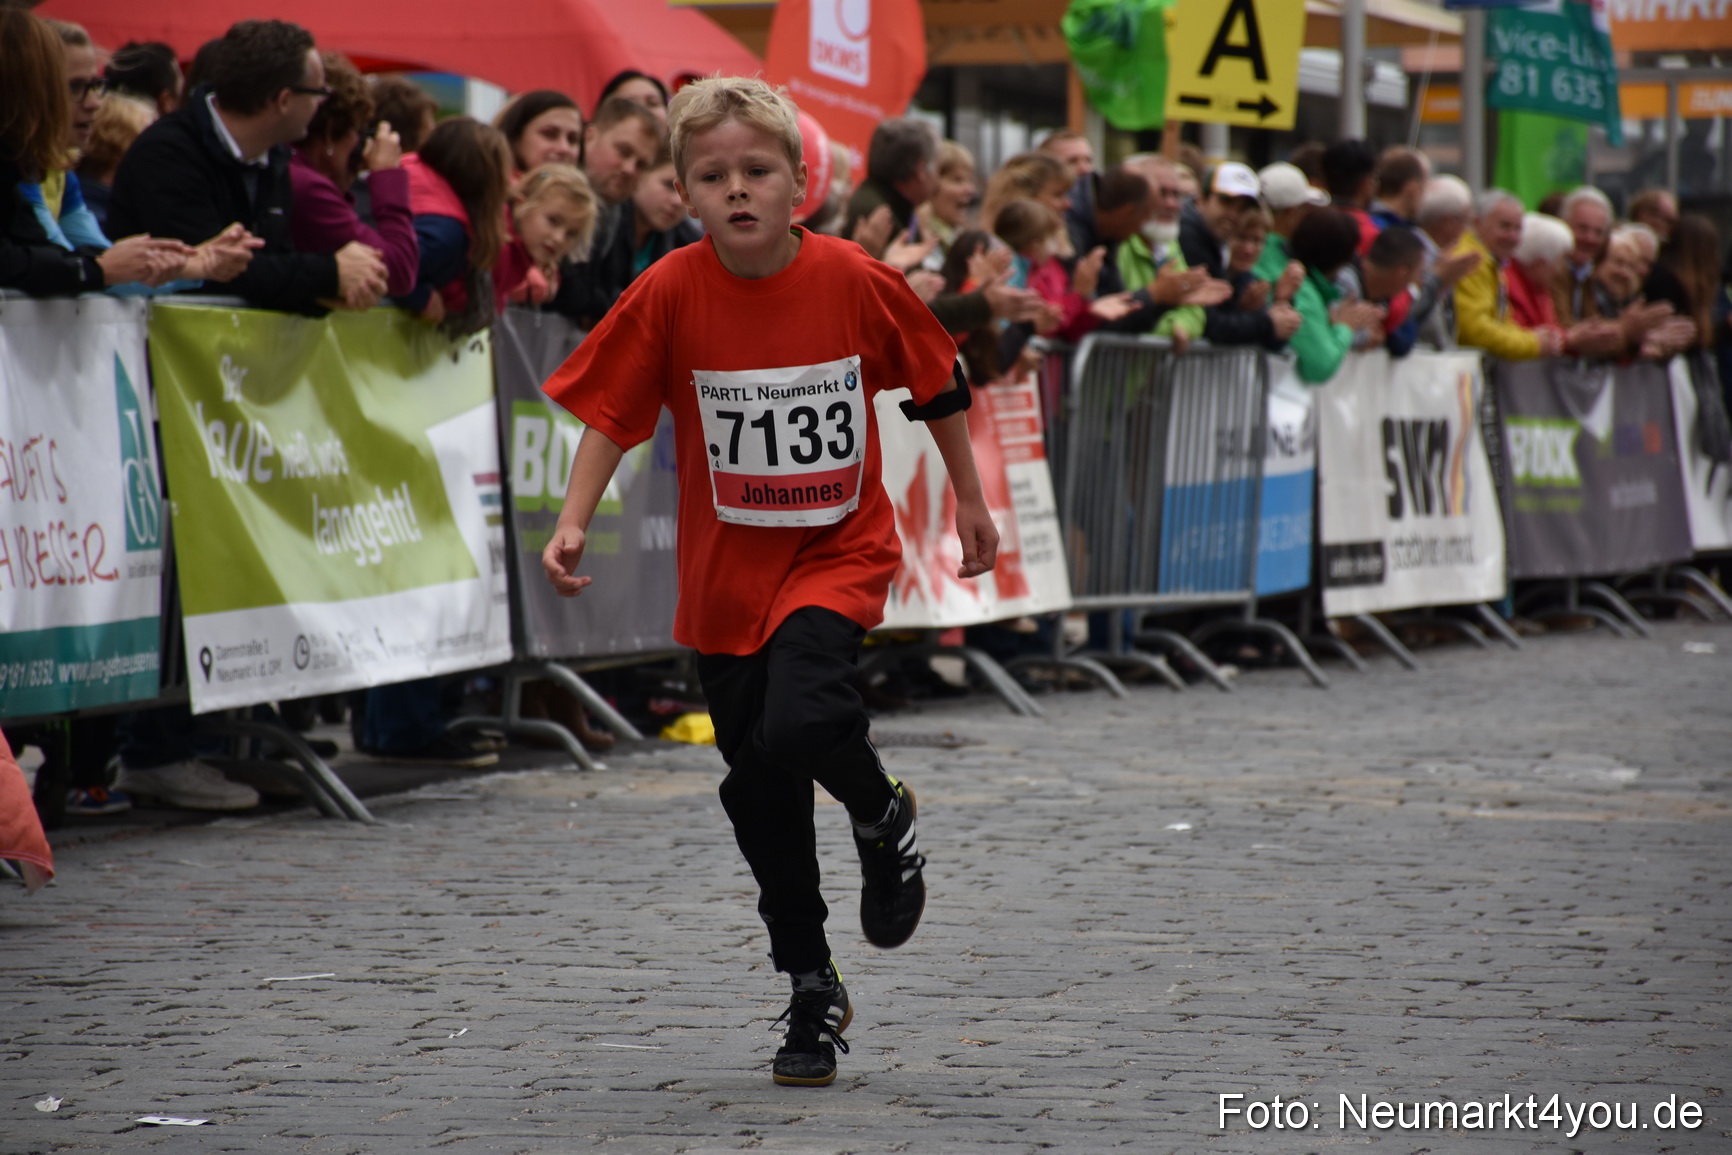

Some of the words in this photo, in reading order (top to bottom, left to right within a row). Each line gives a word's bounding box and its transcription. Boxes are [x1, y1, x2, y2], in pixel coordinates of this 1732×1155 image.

[1198, 0, 1269, 82] A
[700, 385, 753, 401] PARTL
[757, 379, 840, 400] Neumarkt
[716, 401, 855, 466] 7133
[313, 481, 422, 566] langgeht!
[741, 482, 843, 504] Johannes
